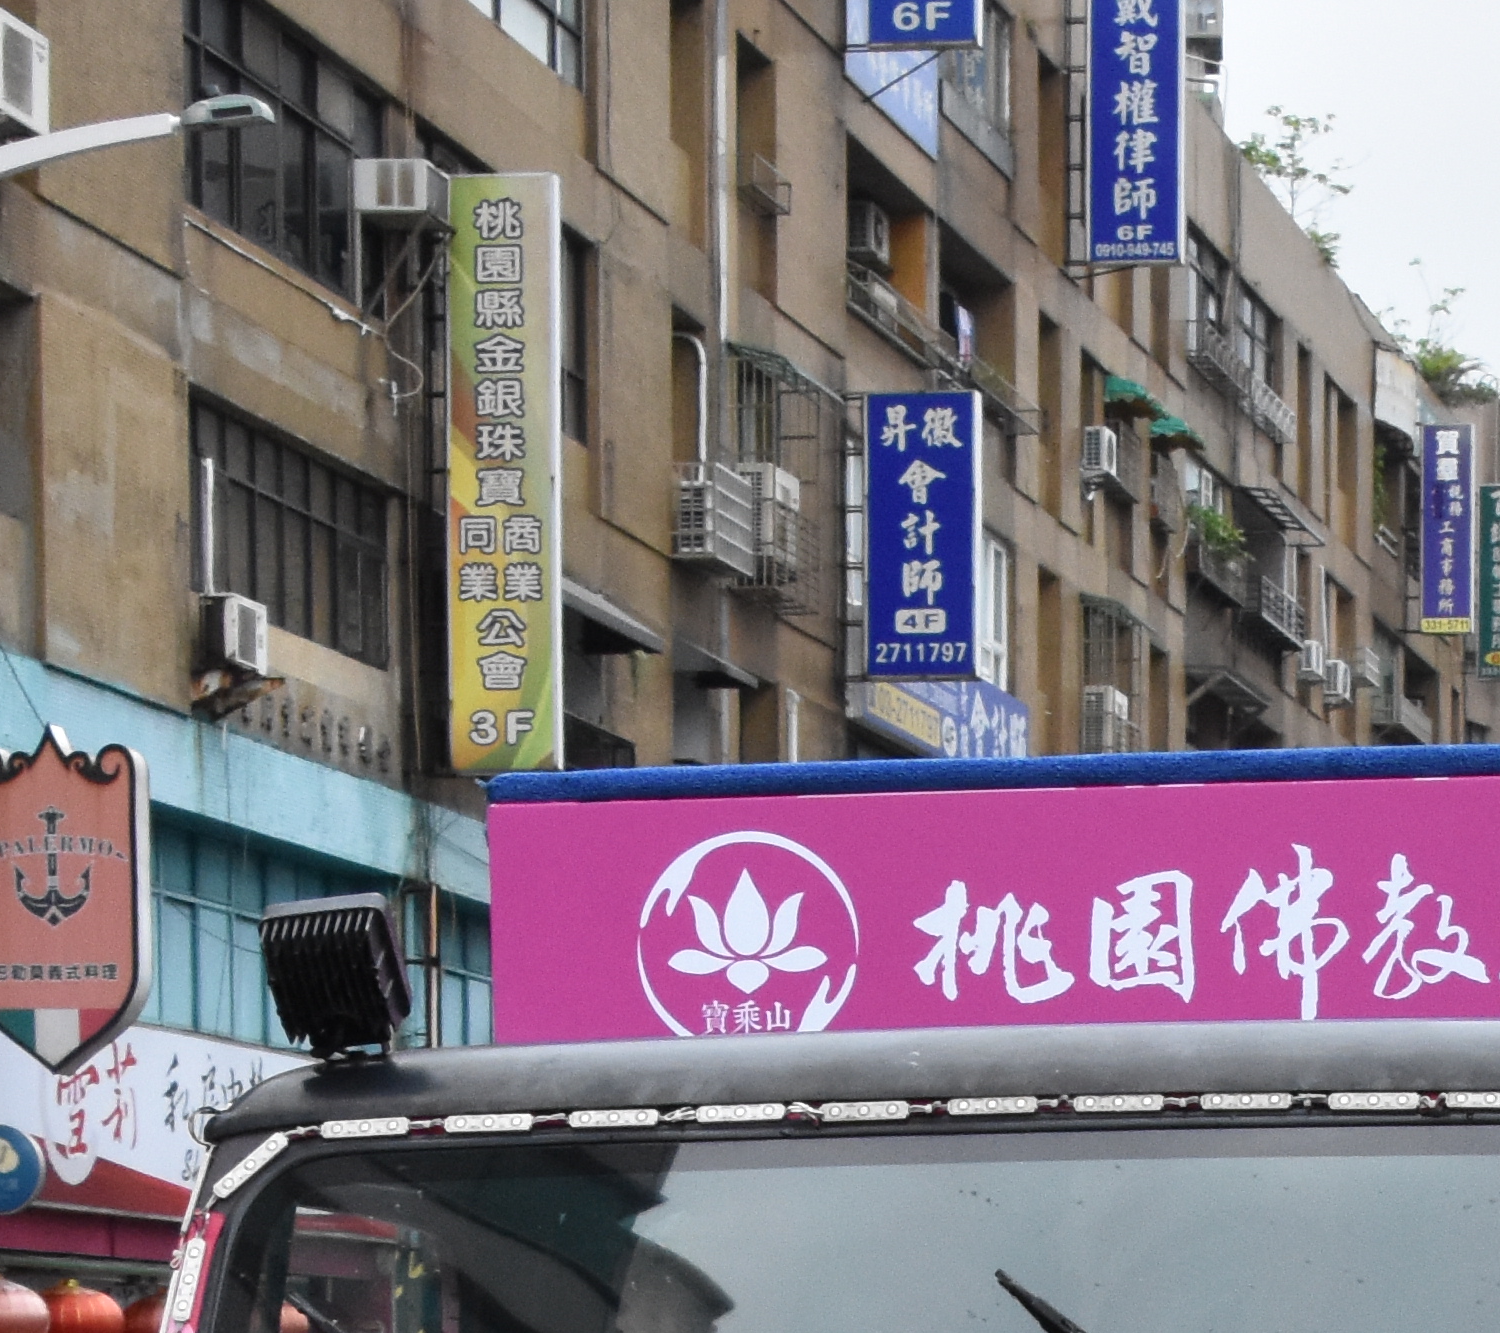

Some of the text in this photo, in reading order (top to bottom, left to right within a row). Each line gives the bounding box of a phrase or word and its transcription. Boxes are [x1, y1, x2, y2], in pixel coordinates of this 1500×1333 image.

[893, 1, 951, 31] 6F
[1118, 225, 1153, 241] 6F
[458, 199, 542, 692] 桃園縣金銀珠寶 商業 同業 公會
[899, 459, 946, 605] 會計師
[902, 613, 939, 630] 4F
[876, 642, 967, 663] 2711797
[469, 709, 534, 747] 3F
